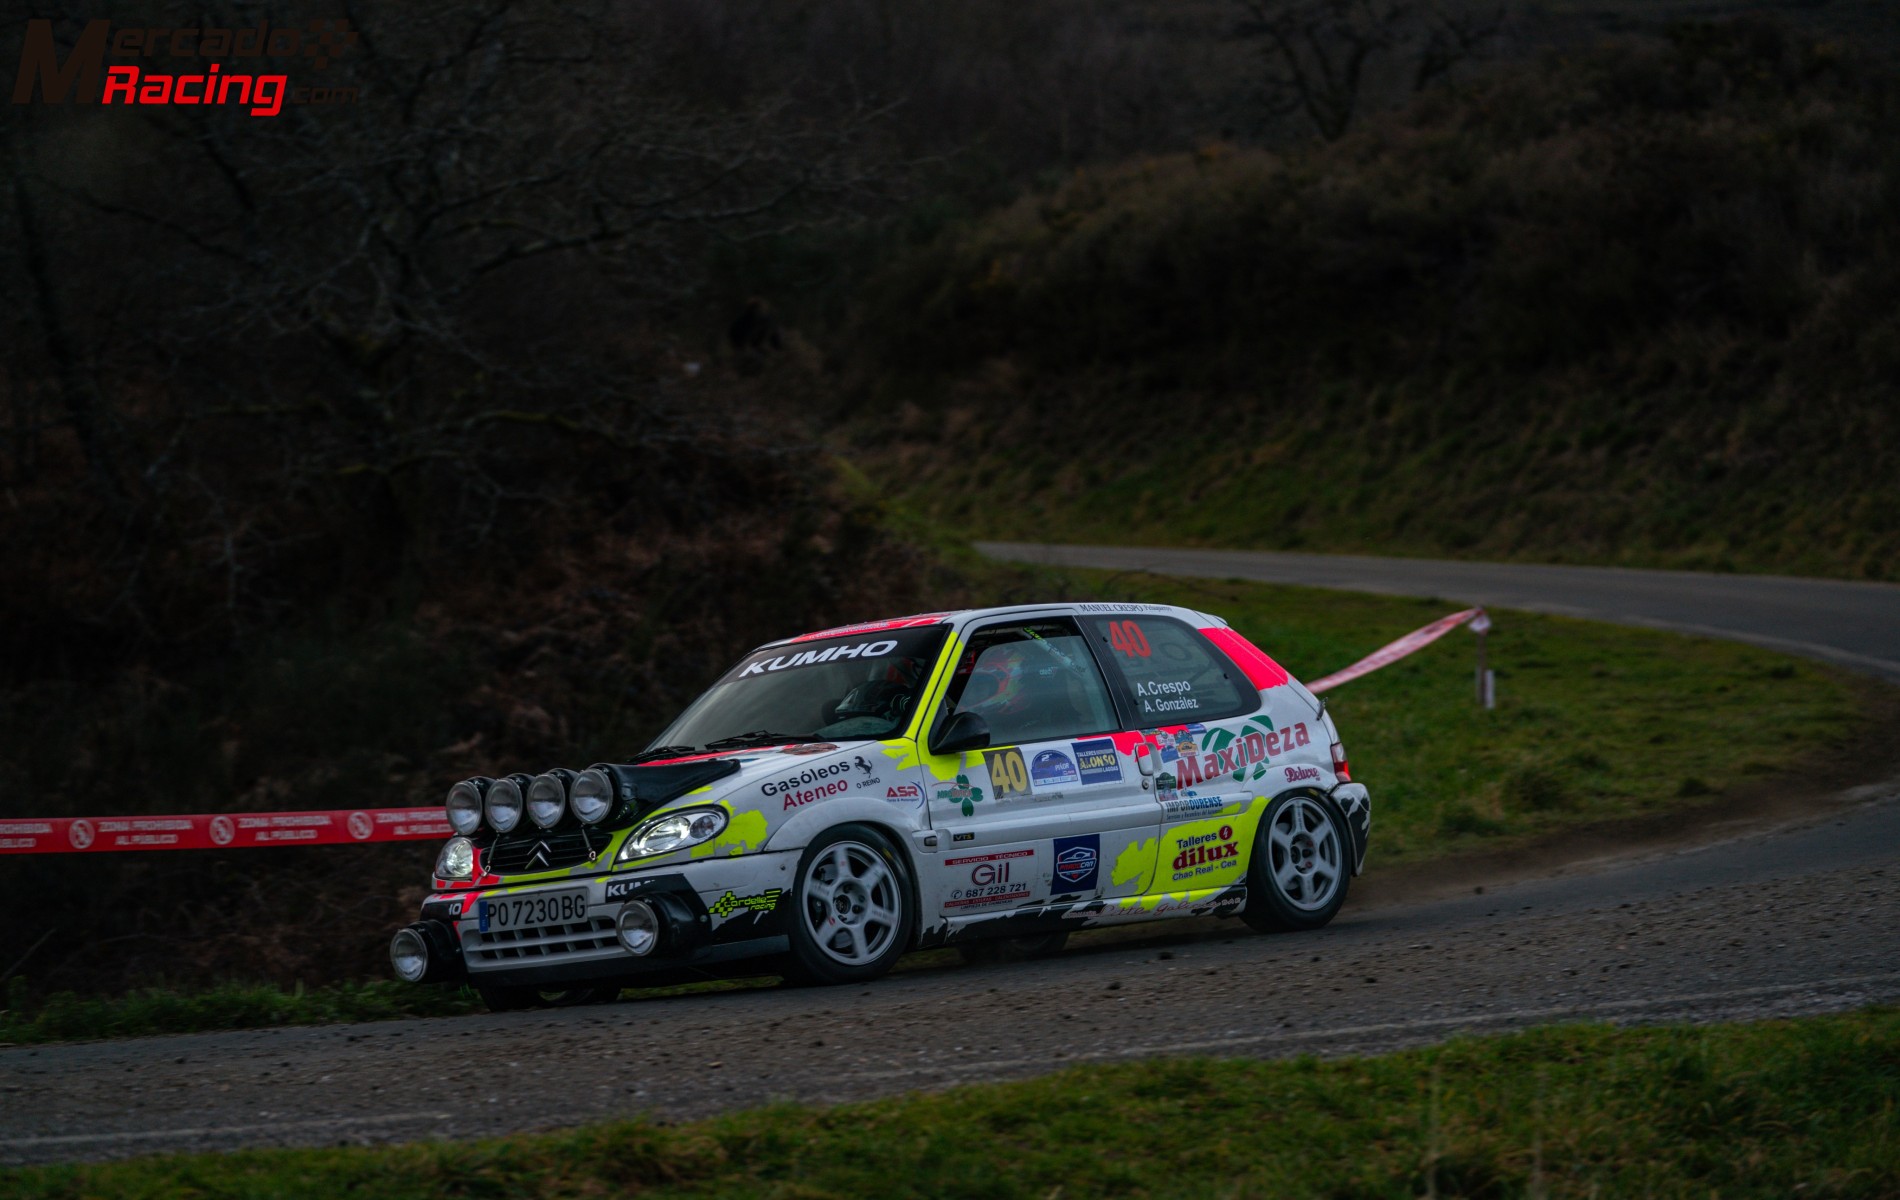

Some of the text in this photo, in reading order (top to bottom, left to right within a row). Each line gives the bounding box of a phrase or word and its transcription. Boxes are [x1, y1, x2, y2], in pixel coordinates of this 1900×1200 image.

[1080, 604, 1114, 612] MANUEL
[1113, 604, 1143, 612] CRESPO
[1109, 619, 1152, 658] 40
[739, 640, 898, 678] KUMHO
[1137, 680, 1191, 697] A.Crespo
[1144, 696, 1199, 713] A. González
[1079, 753, 1116, 769] ALONSO
[1176, 721, 1311, 790] MaxiDeza
[760, 760, 850, 797] Gasóleos
[991, 751, 1027, 793] 40
[1284, 766, 1320, 783] Deluxe
[862, 777, 881, 788] REINO
[783, 779, 848, 811] Ateneo
[887, 786, 919, 797] ASR
[1176, 832, 1217, 850] Talleres
[952, 850, 1027, 865] SERVICIO TÉCNICO
[1172, 841, 1239, 871] dilux
[972, 862, 1009, 886] Gil
[1172, 871, 1194, 882] Chao
[1195, 865, 1214, 876] Real
[966, 883, 1026, 899] 687 228 721
[512, 897, 559, 926] 7230
[561, 894, 585, 922] BG
[748, 902, 776, 912] racing
